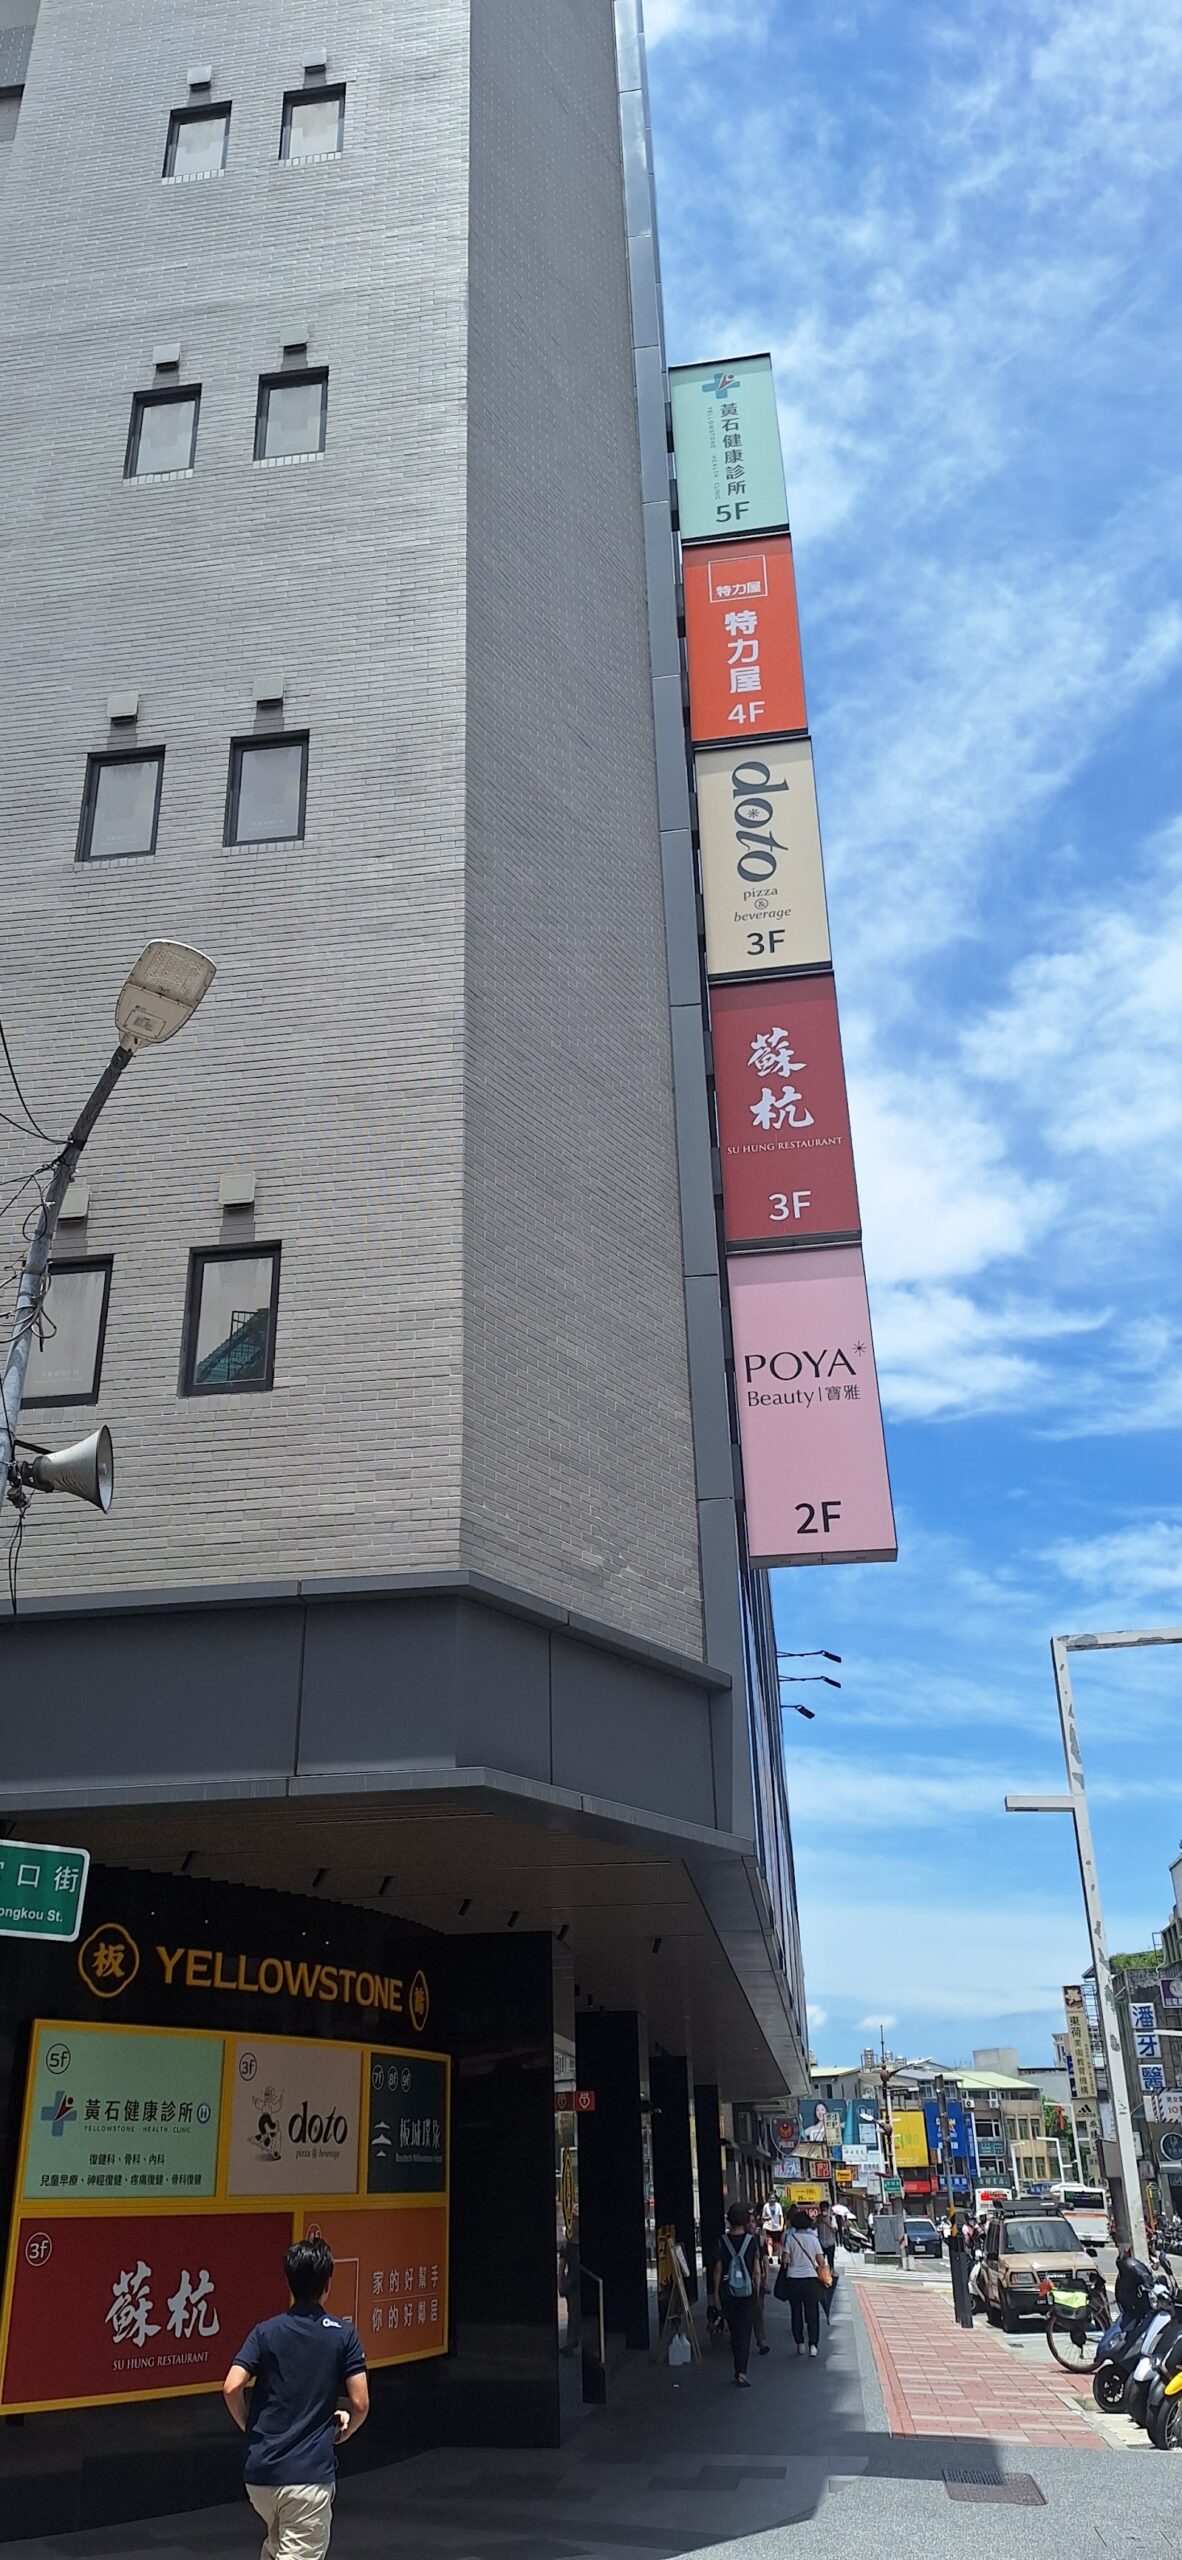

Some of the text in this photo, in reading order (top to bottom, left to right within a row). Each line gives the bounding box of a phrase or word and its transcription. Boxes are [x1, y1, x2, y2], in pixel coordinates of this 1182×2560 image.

[720, 402, 747, 496] 黃石健康診所
[715, 501, 750, 523] 5F
[716, 580, 761, 598] 特力屋
[724, 609, 762, 695] 特力屋
[727, 700, 765, 725] 4F
[731, 761, 790, 883] doto
[743, 887, 778, 901] pizza
[734, 906, 792, 923] beverage
[746, 929, 786, 956] 3F
[748, 1027, 815, 1131] 蘇杭
[727, 1136, 843, 1155] SU HUNG RESTAURANT
[768, 1190, 812, 1221] 3F
[744, 1348, 857, 1383] POYA
[747, 1388, 814, 1408] Beauty
[826, 1384, 861, 1401] 寶雅
[794, 1500, 842, 1534] 2F
[0, 1862, 79, 1893] 口街
[47, 1909, 63, 1922] St.
[92, 1942, 126, 1978] 板
[156, 1946, 403, 2013] YELLOWSTONE
[1133, 2005, 1163, 2089] 潘牙醫
[84, 2098, 193, 2123] 黃石健康診所
[288, 2101, 348, 2145] doto
[84, 2125, 135, 2133] YELLOWSTONE
[28, 2238, 50, 2261] 3f
[104, 2260, 220, 2348] 蘇杭
[113, 2352, 209, 2371] SU HUNG RESTAURANT
